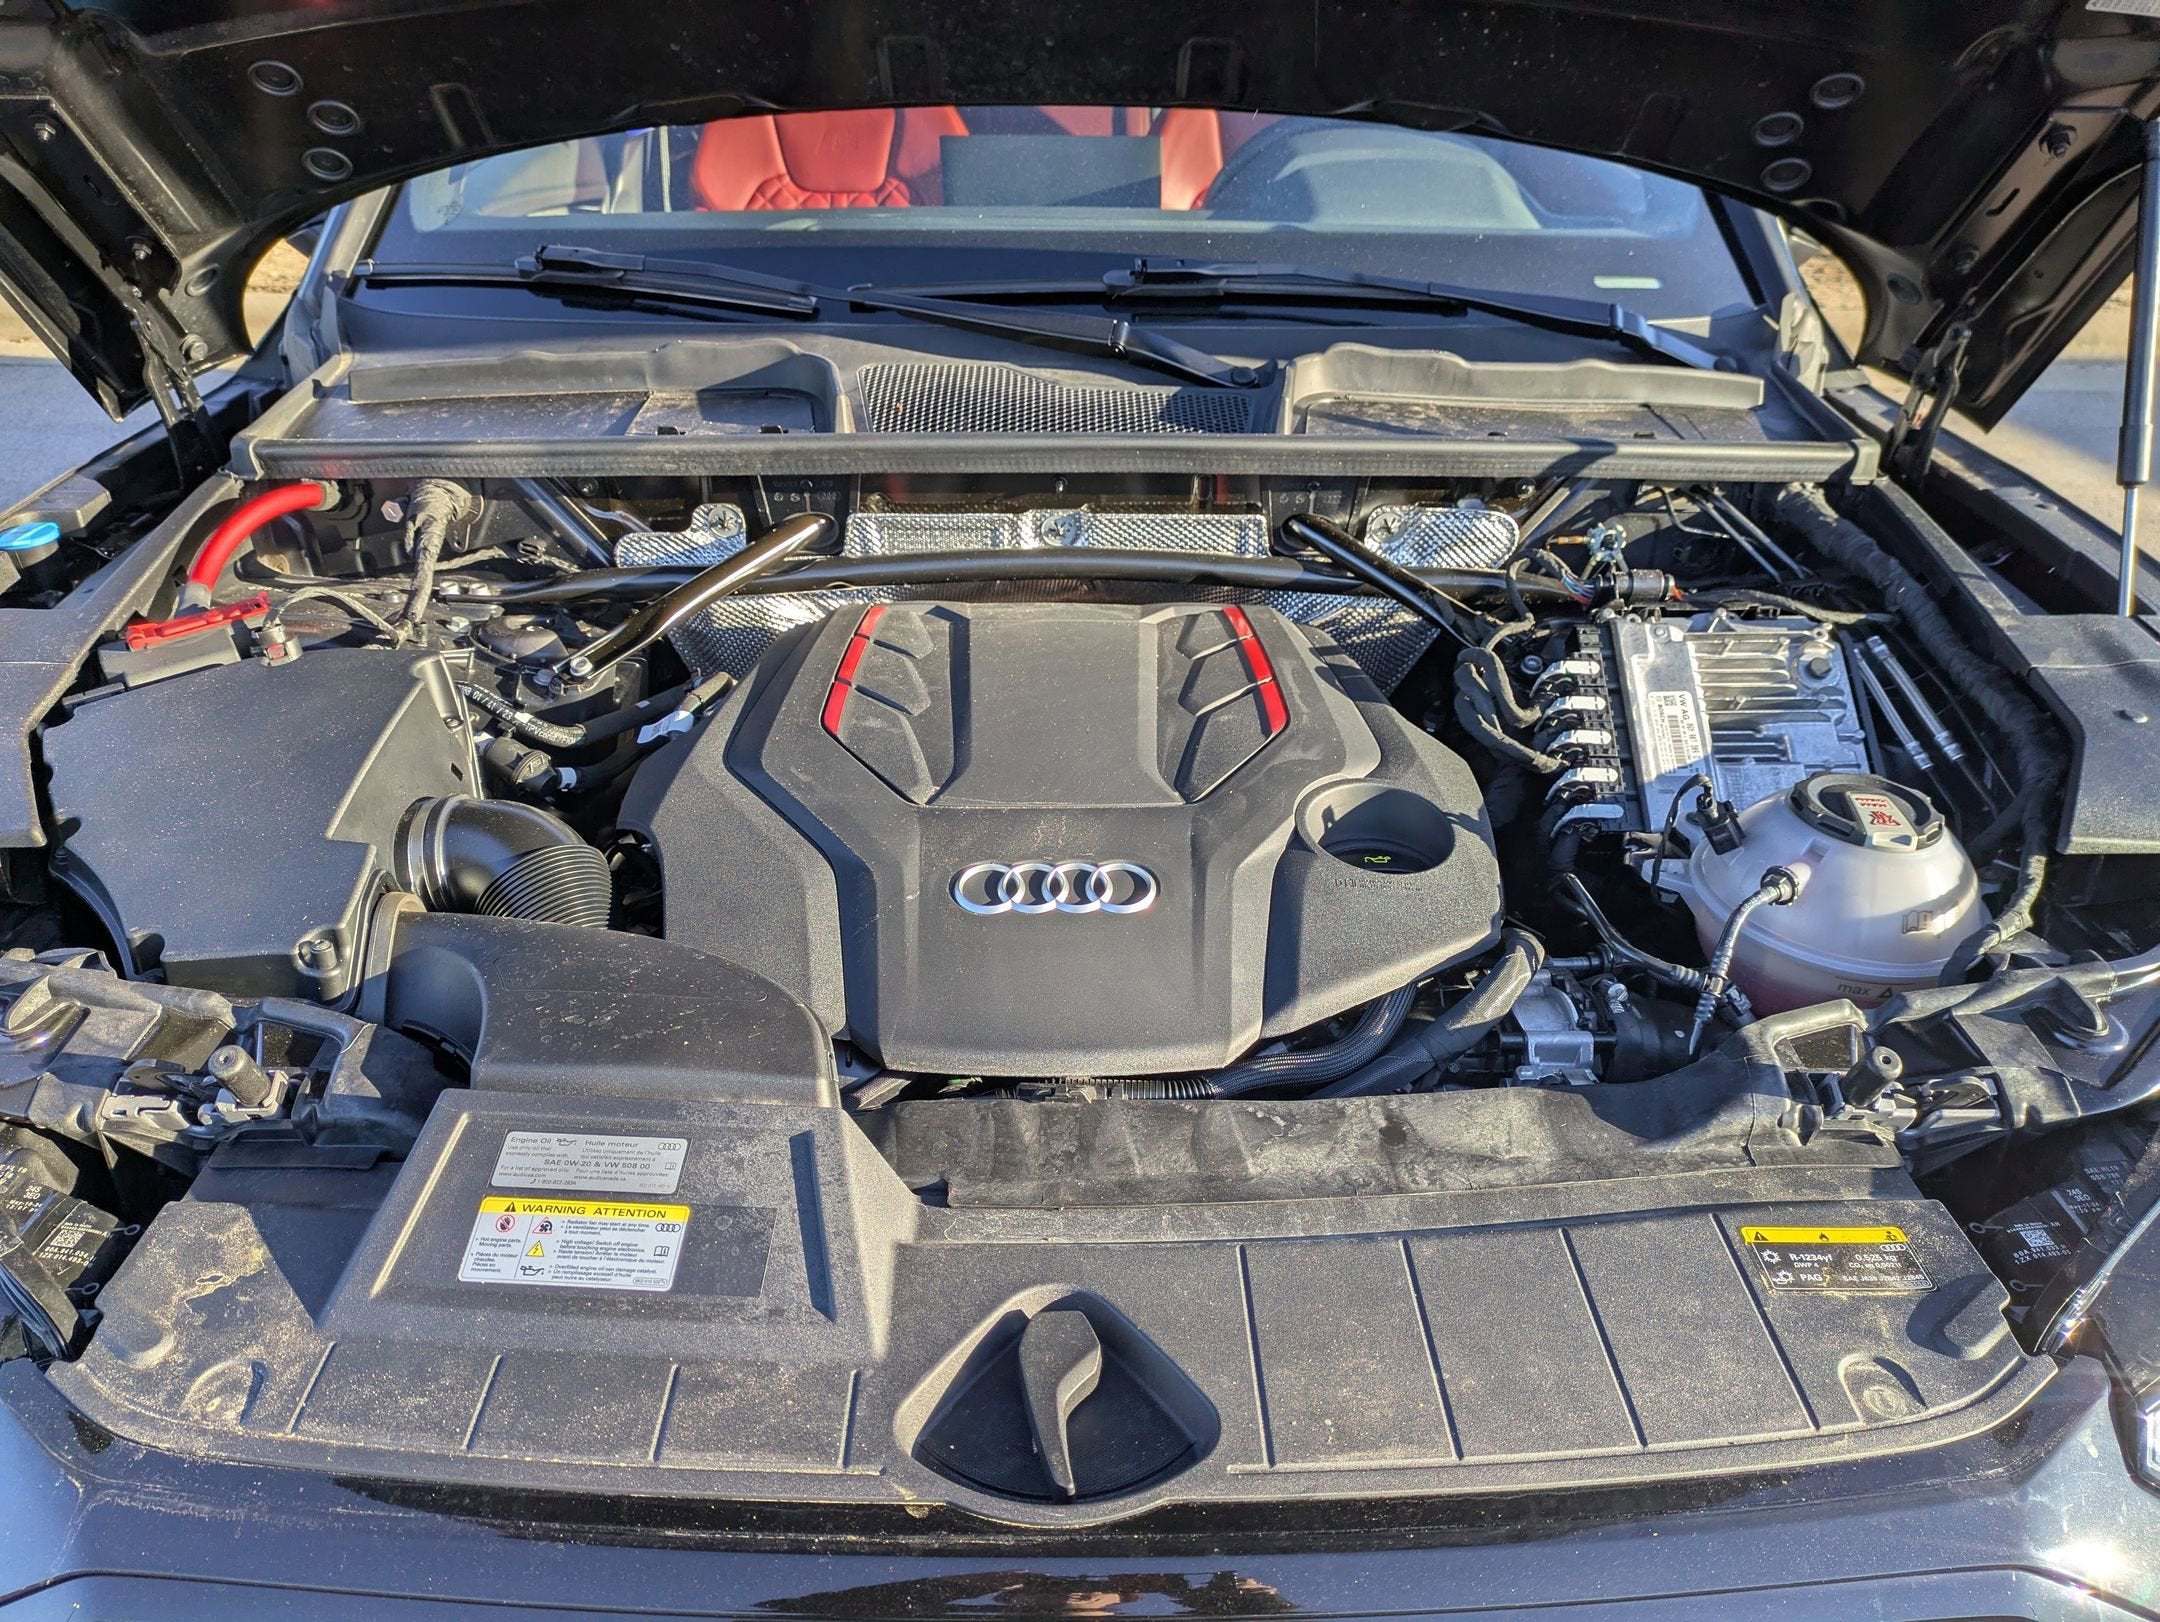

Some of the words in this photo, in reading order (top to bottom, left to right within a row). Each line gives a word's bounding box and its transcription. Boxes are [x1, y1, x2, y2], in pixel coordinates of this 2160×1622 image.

[1678, 693, 1688, 709] VW
[1681, 709, 1690, 721] AG
[1837, 983, 1872, 996] max
[522, 1204, 586, 1215] WARNING
[593, 1207, 667, 1219] ATTENTION
[1789, 1253, 1833, 1262] R-1234yf
[1883, 1253, 1898, 1262] kg
[1800, 1273, 1823, 1282] PAG
